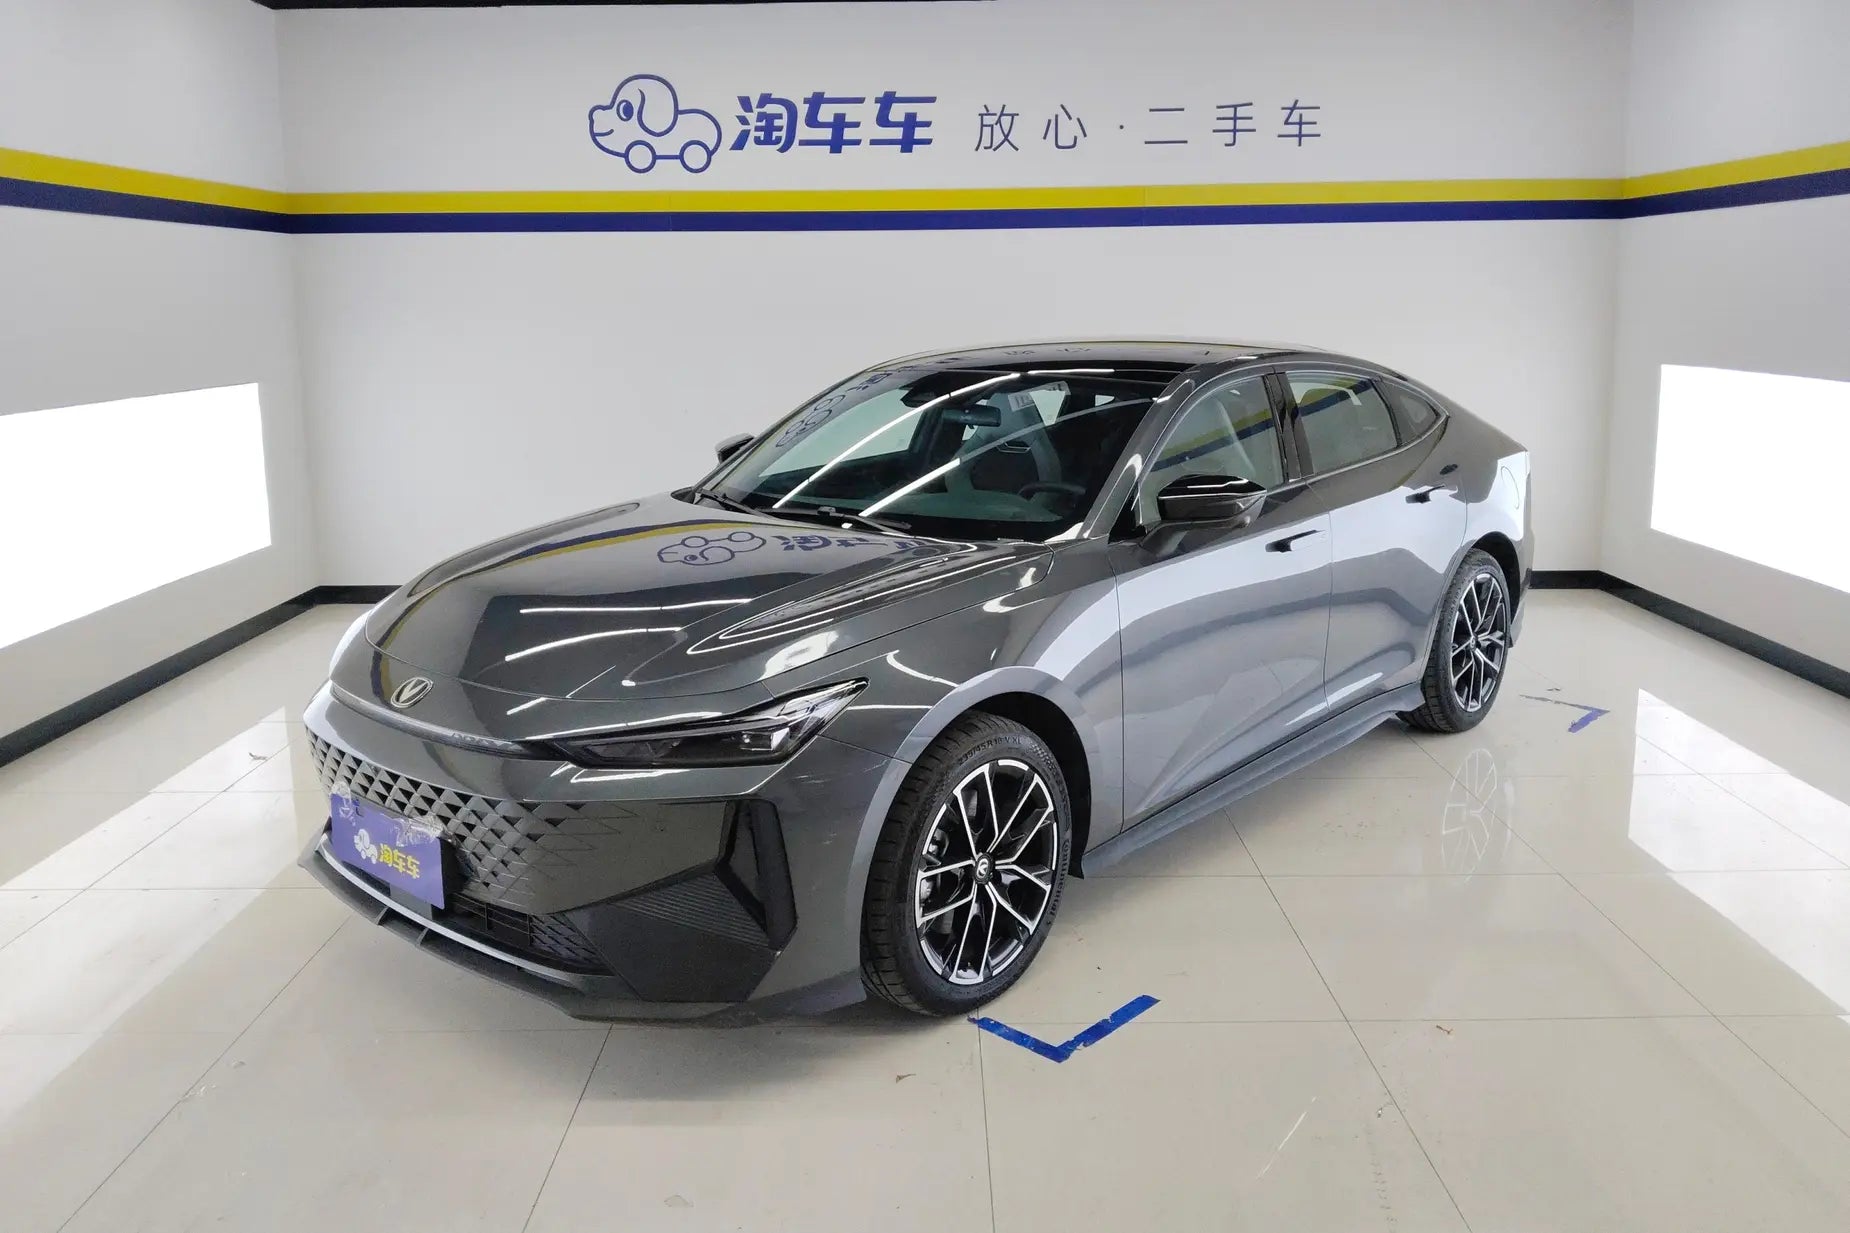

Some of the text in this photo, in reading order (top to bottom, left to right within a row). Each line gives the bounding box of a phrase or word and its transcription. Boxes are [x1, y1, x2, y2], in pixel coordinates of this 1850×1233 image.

[729, 91, 937, 153] 淘车车
[379, 843, 420, 879] 淘车车
